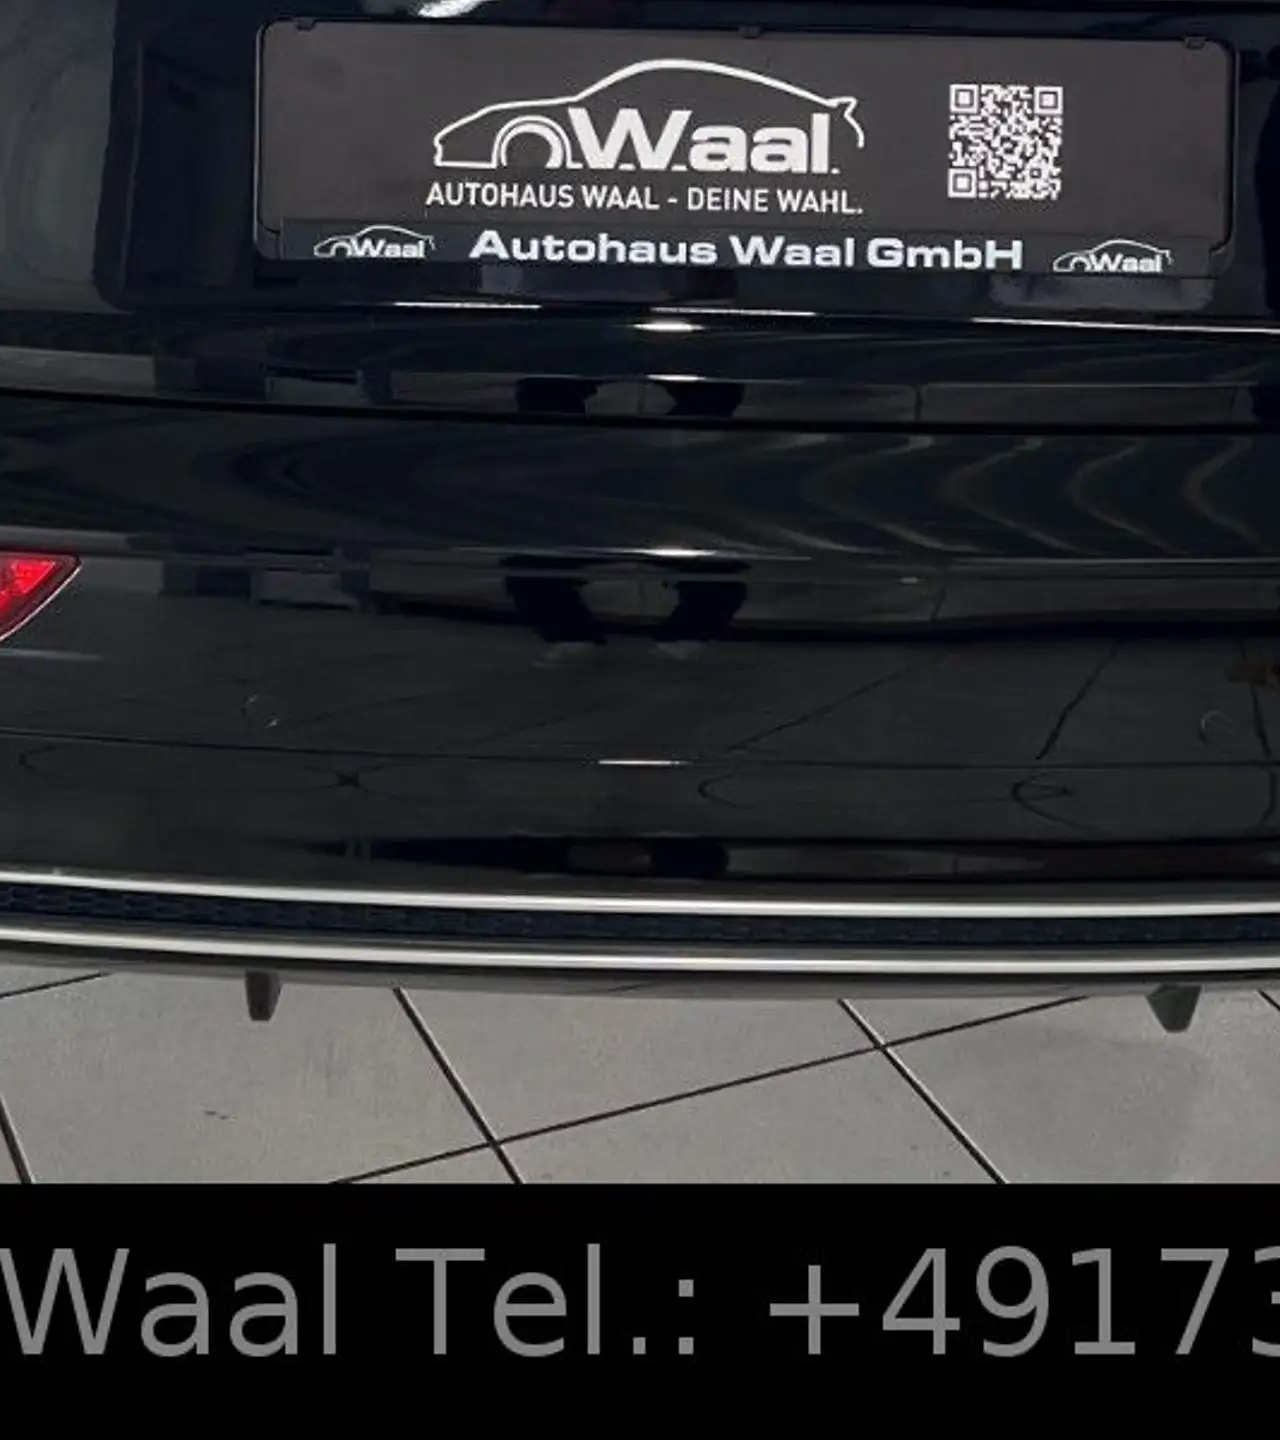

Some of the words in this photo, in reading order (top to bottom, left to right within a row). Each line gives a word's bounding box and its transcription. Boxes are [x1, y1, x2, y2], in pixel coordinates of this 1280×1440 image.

[567, 107, 830, 174] Waal
[425, 181, 575, 209] AUTOHAUS
[580, 184, 660, 210] WAAL
[687, 186, 770, 213] DEINE
[776, 188, 865, 215] WAHL.
[351, 238, 425, 258] Waal
[468, 229, 719, 265] Autohaus
[727, 235, 856, 267] Waal
[866, 237, 1023, 270] GmbH
[1090, 253, 1162, 273] Waal
